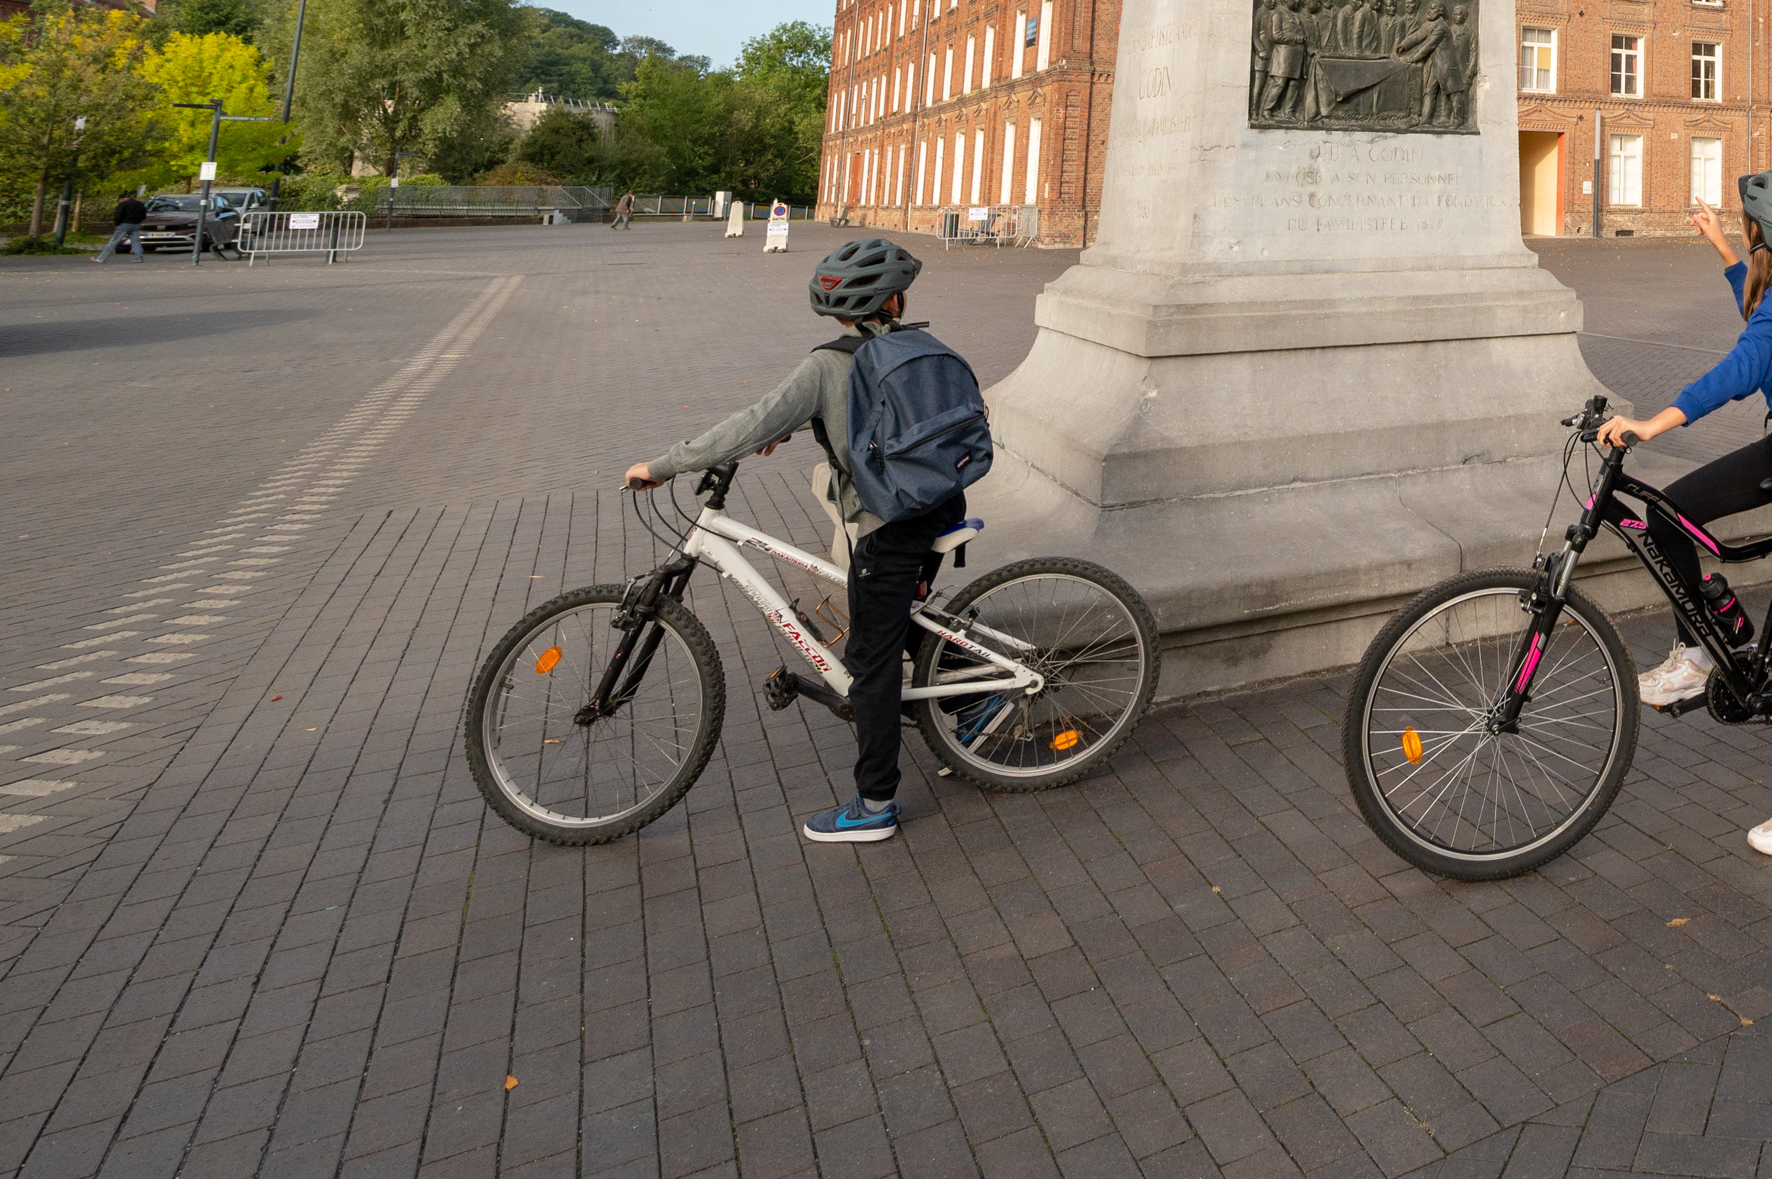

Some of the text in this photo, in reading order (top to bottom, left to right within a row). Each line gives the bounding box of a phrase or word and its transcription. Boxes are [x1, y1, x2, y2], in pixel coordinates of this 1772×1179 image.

[1138, 66, 1172, 101] GODIN
[1369, 145, 1425, 164] GODIN
[1347, 171, 1377, 185] SON
[1383, 172, 1464, 187] PERSONNEL
[1308, 193, 1404, 209] CONCERNANT
[1412, 194, 1430, 208] LA
[1287, 217, 1308, 231] DU
[936, 629, 991, 660] HARDTAIL
